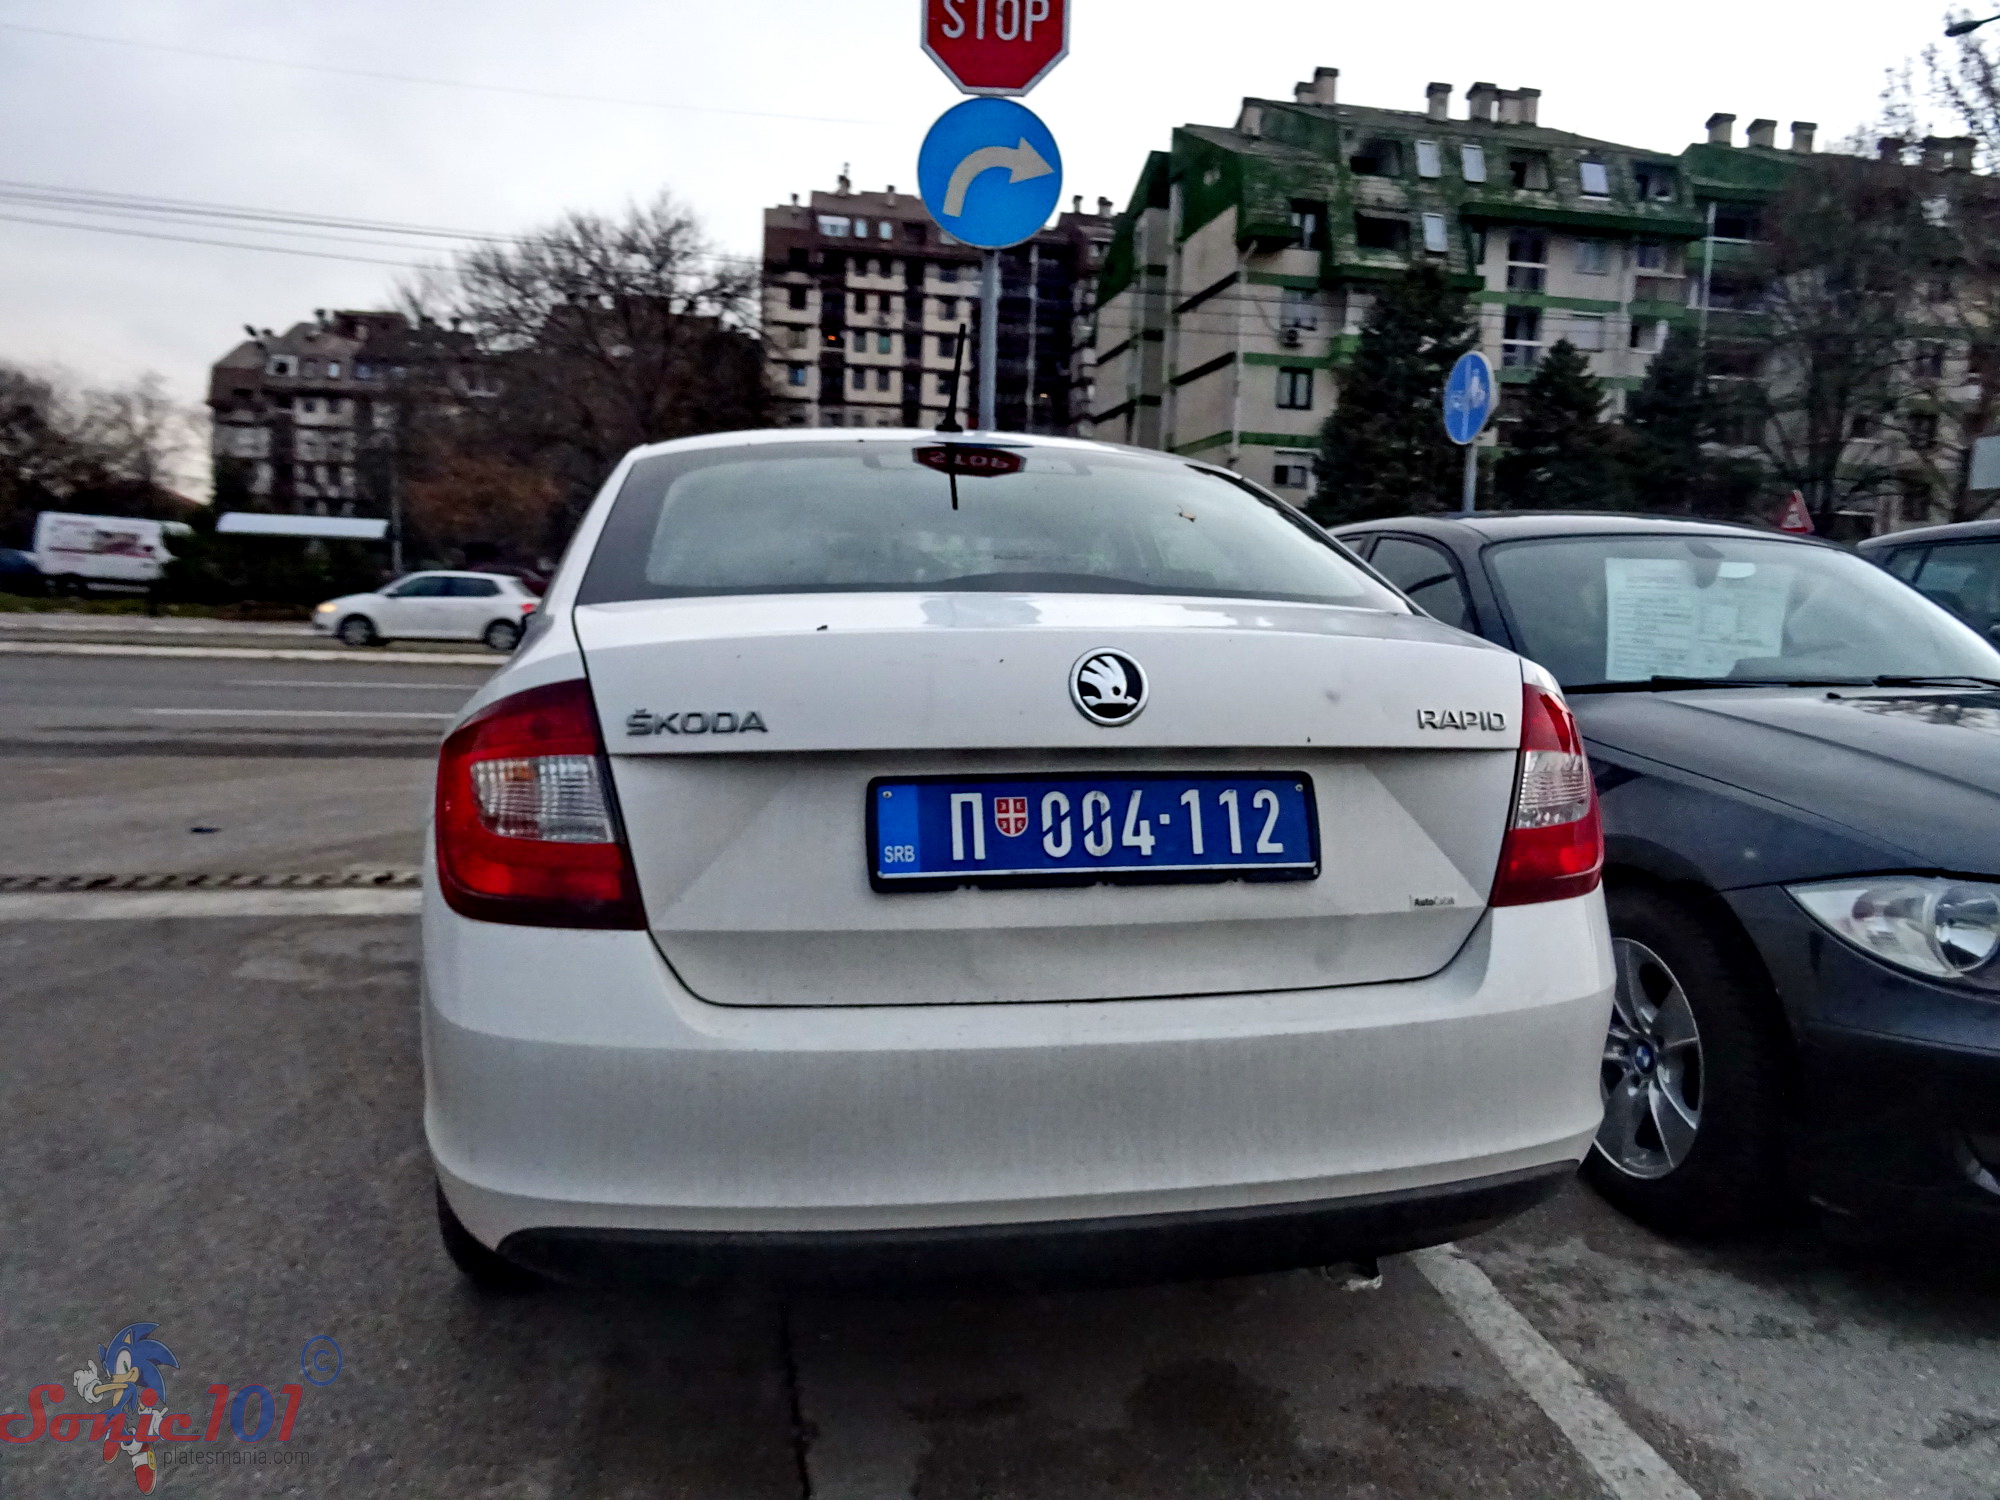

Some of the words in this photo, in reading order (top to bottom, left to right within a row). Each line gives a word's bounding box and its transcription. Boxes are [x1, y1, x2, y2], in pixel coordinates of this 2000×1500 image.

[942, 0, 1050, 41] STOP
[626, 708, 768, 736] ŠKODA
[1416, 708, 1507, 731] RAPID
[884, 845, 915, 863] SRB
